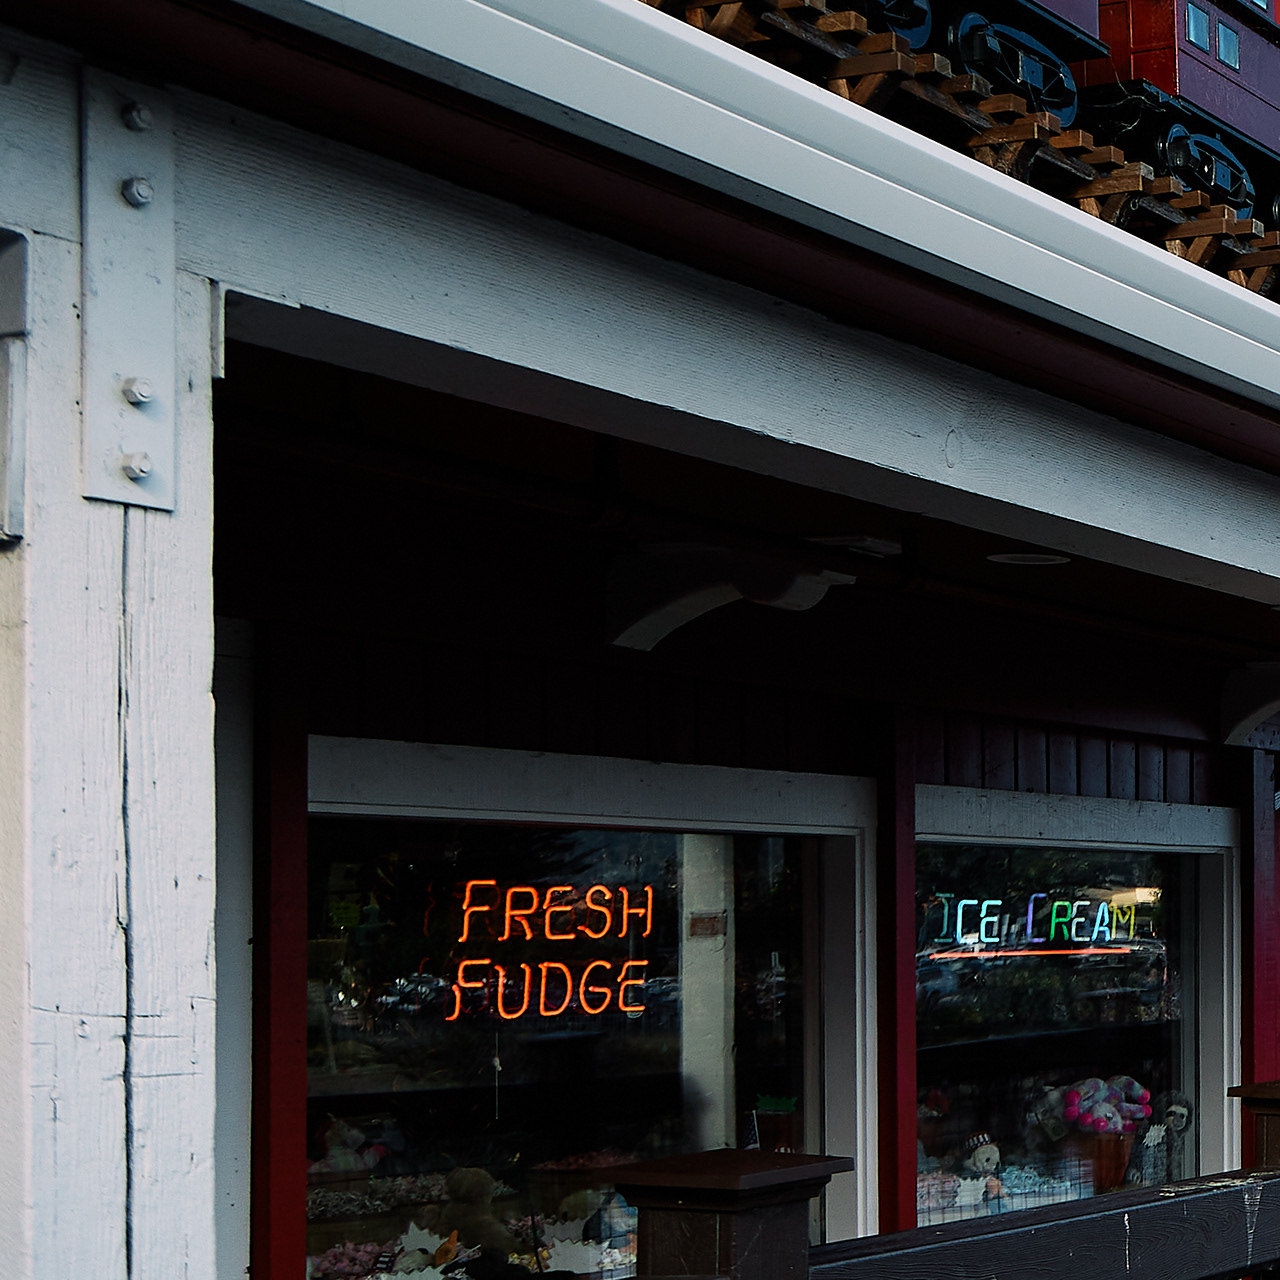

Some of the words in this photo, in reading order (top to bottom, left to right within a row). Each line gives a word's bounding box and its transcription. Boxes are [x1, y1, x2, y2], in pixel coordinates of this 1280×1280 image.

[458, 879, 653, 942] FRESH
[934, 892, 1003, 944] ICE
[1027, 893, 1136, 943] CREAM
[445, 958, 649, 1021] FUDGE
